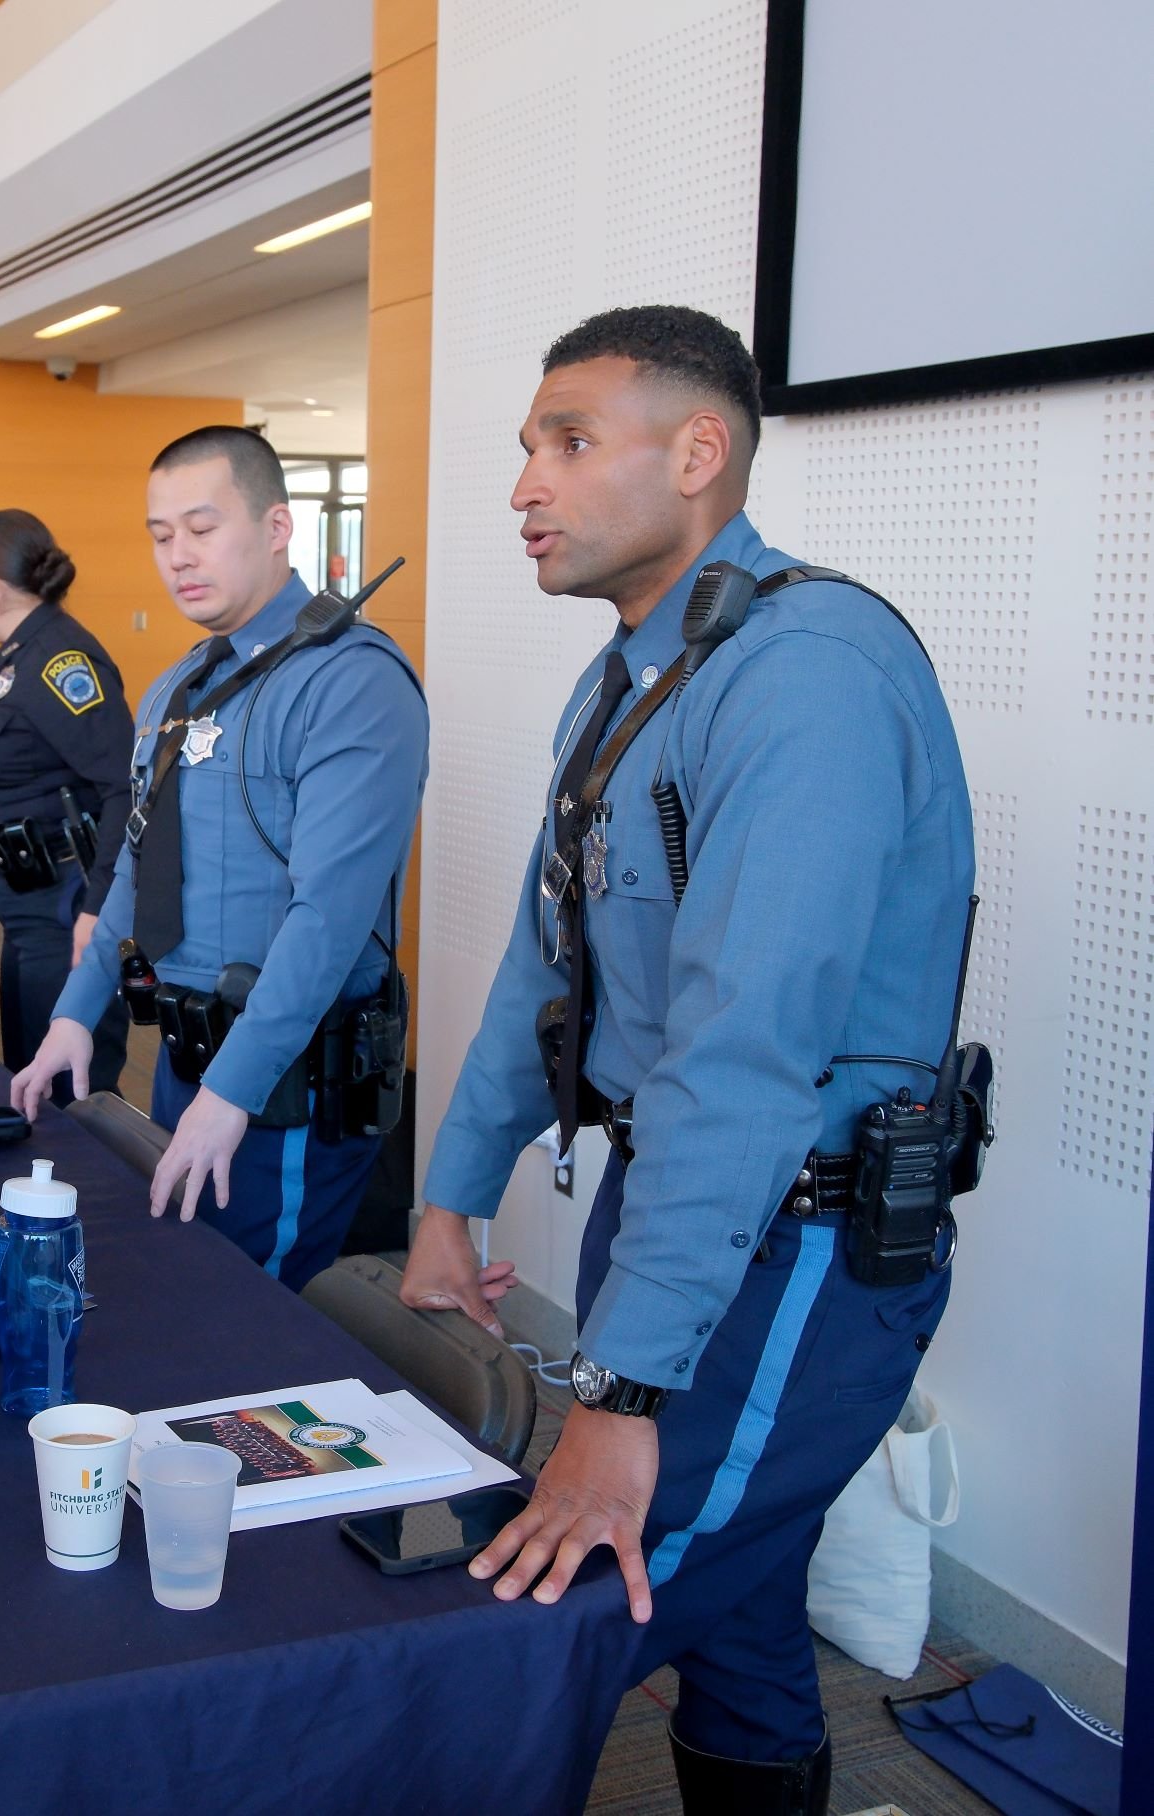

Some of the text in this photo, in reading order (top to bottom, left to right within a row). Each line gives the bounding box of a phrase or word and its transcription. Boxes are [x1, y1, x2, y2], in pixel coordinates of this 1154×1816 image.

[48, 655, 84, 679] POLICE
[49, 1491, 104, 1504] FITCHBURG
[50, 1495, 125, 1515] UNIVERSITY
